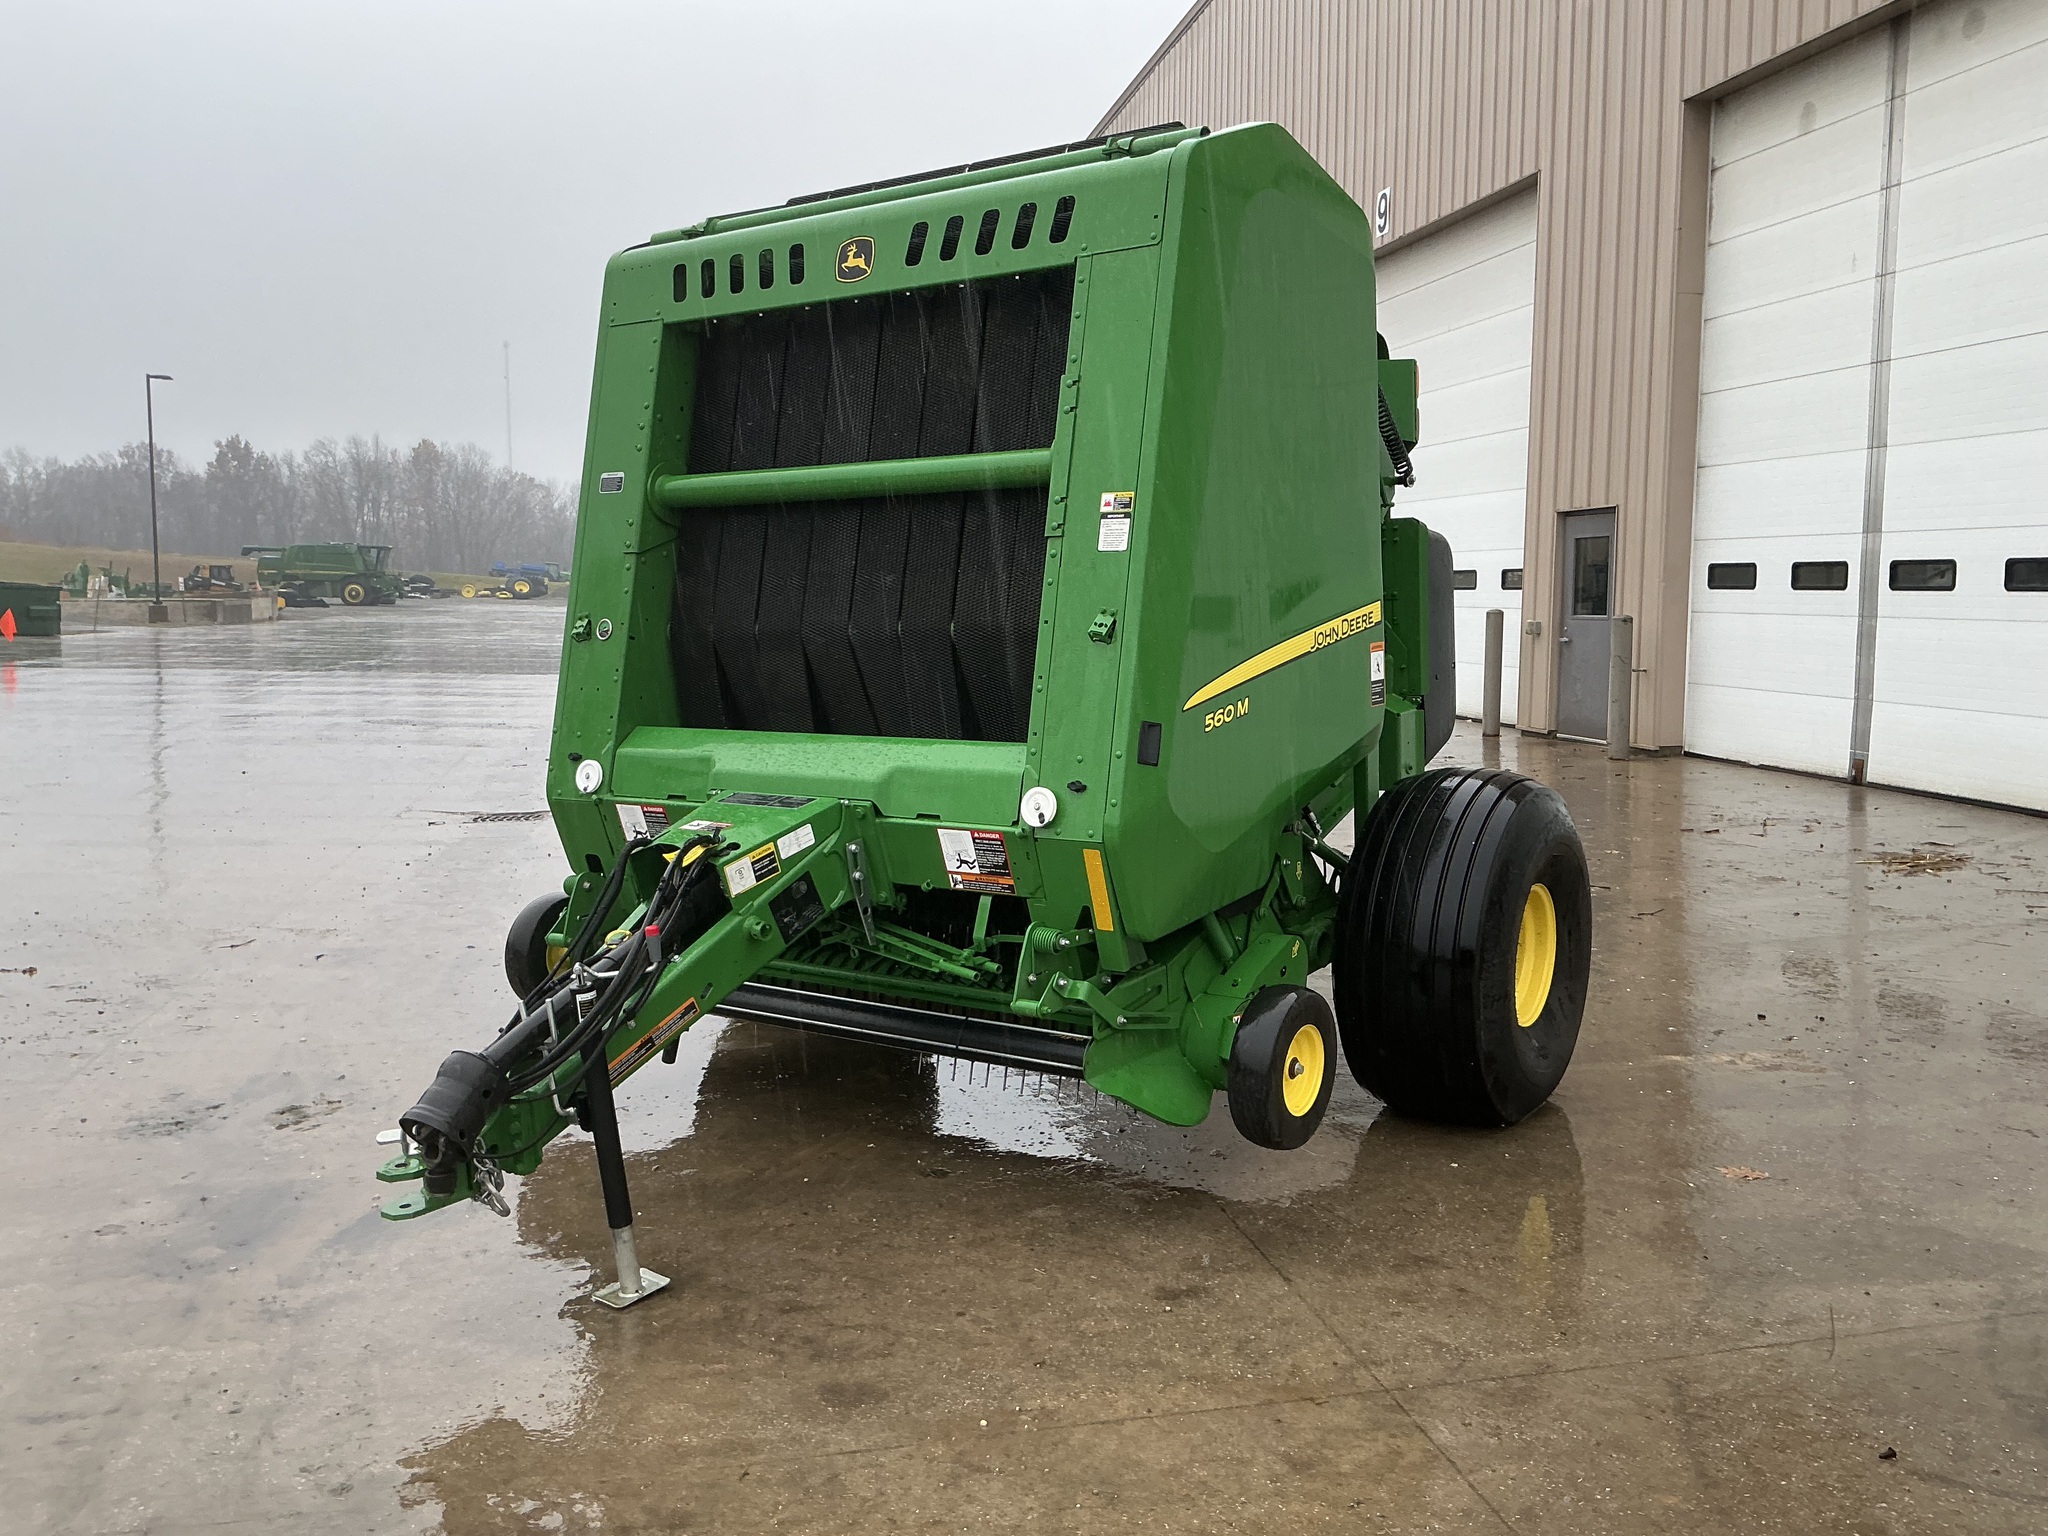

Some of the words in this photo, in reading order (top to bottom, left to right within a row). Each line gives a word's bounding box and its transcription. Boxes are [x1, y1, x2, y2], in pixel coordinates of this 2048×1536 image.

[1378, 192, 1388, 233] 9
[1310, 624, 1339, 650] JOHN
[1341, 611, 1374, 636] DEERE
[1204, 703, 1235, 733] 560
[1236, 696, 1250, 719] M
[755, 846, 772, 858] CAUTION
